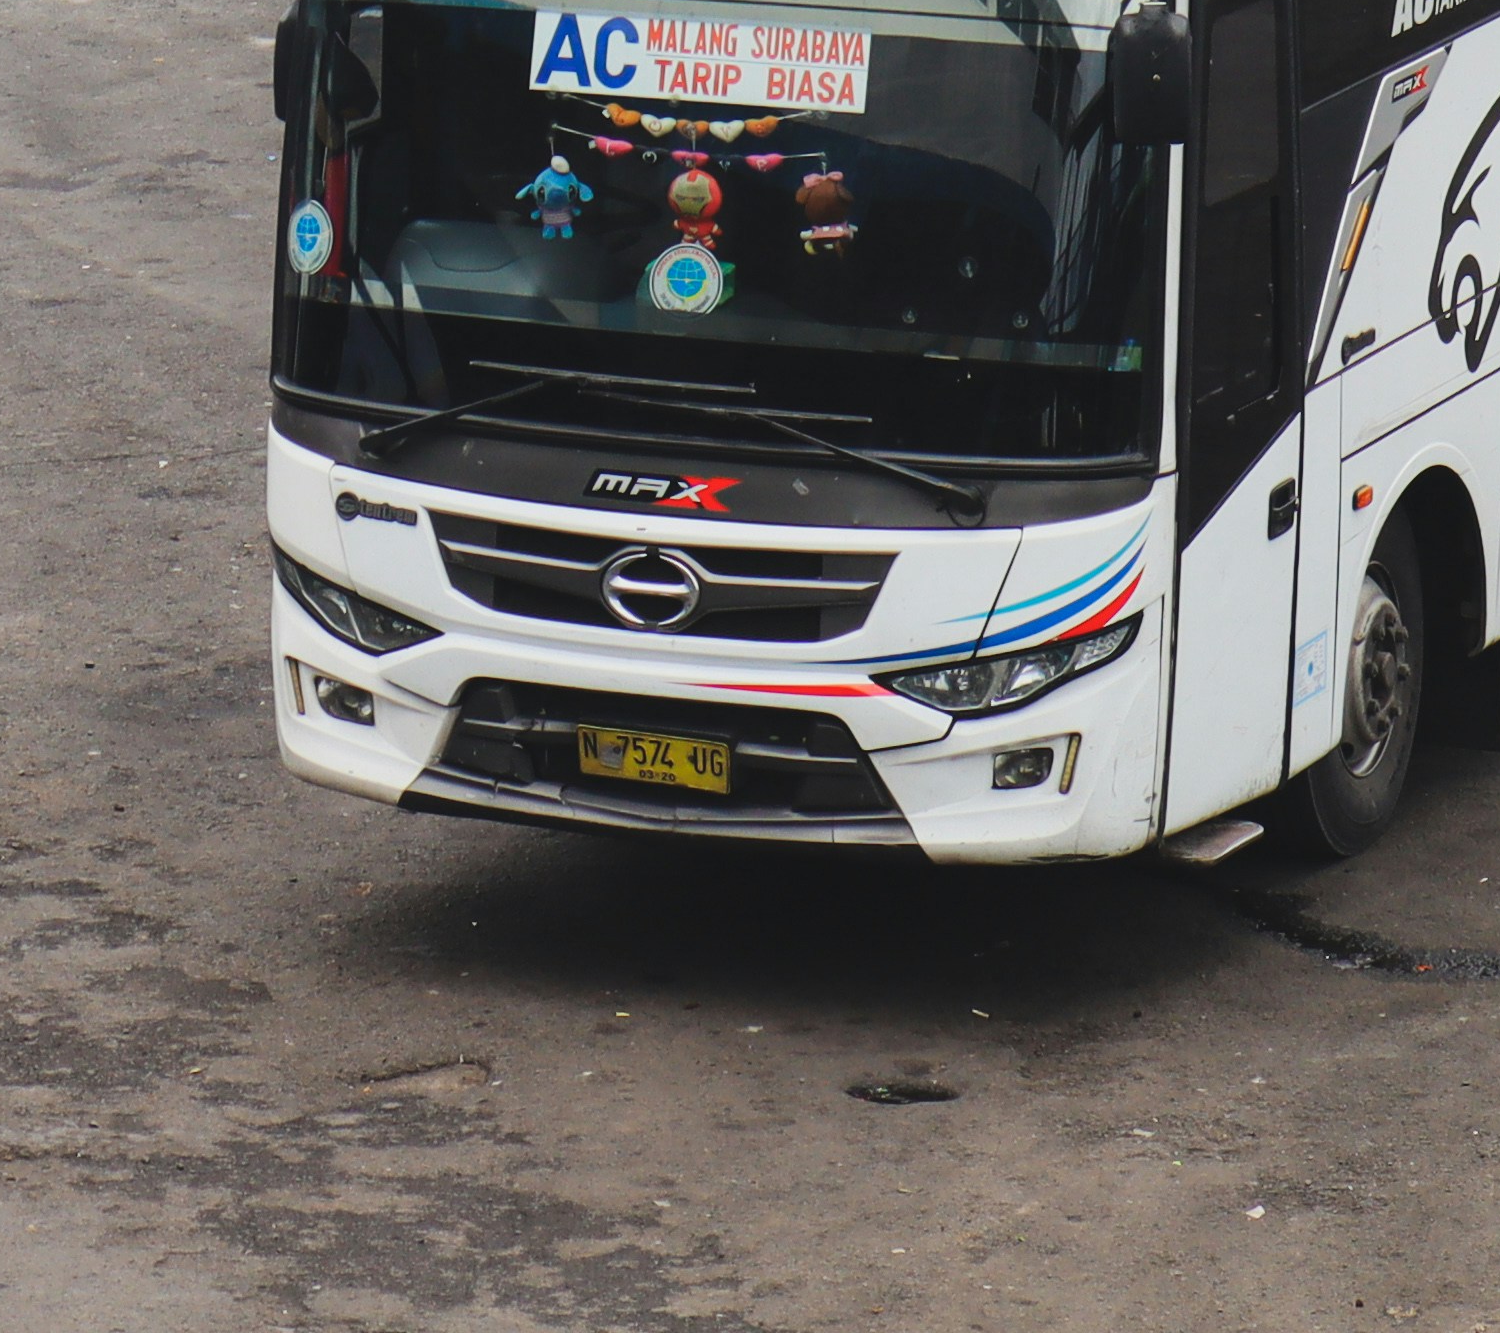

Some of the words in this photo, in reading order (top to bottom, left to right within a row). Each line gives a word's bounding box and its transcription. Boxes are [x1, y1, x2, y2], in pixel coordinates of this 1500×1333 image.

[534, 13, 639, 90] AC
[645, 18, 738, 58] MALANG
[750, 26, 866, 67] SURABAYA
[653, 58, 743, 97] TARIP
[766, 68, 857, 106] BIASA
[582, 732, 598, 758] N
[616, 736, 674, 770] 7574
[693, 745, 724, 777] UG
